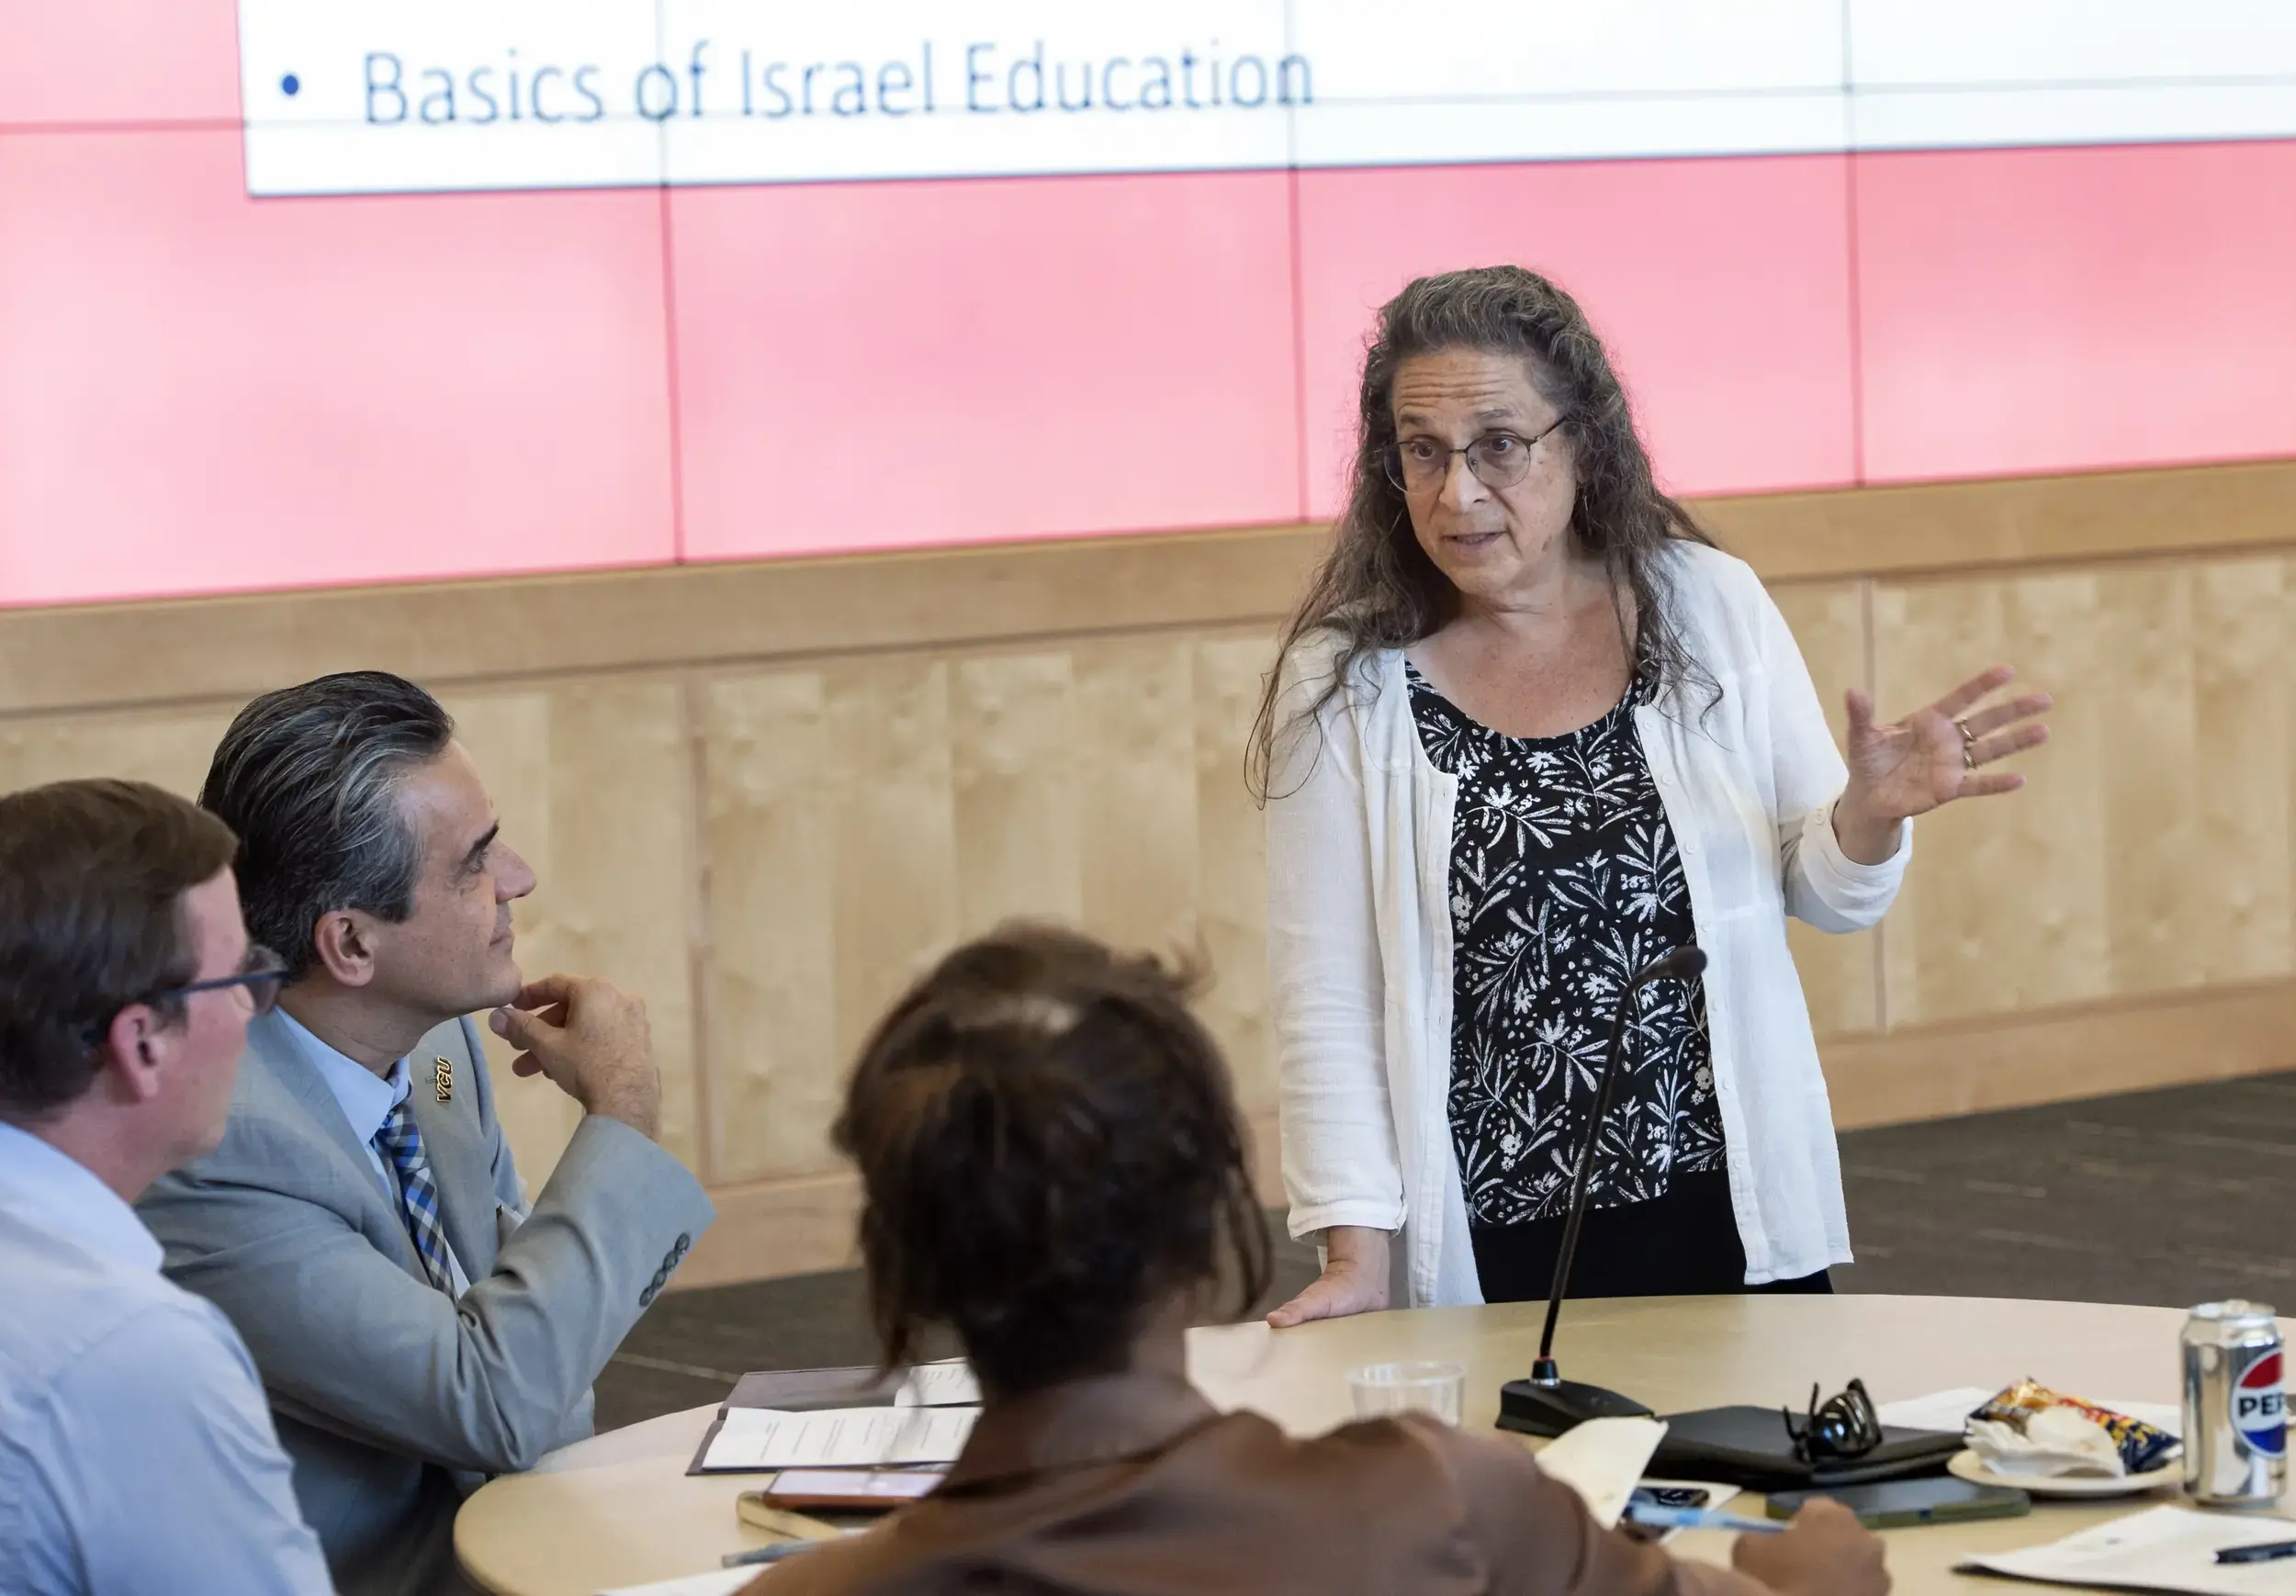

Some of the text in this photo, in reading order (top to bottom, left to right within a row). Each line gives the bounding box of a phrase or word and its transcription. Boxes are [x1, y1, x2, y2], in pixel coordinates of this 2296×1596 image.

[364, 39, 1314, 125] Basics of Israel Education
[436, 1055, 453, 1102] VCU
